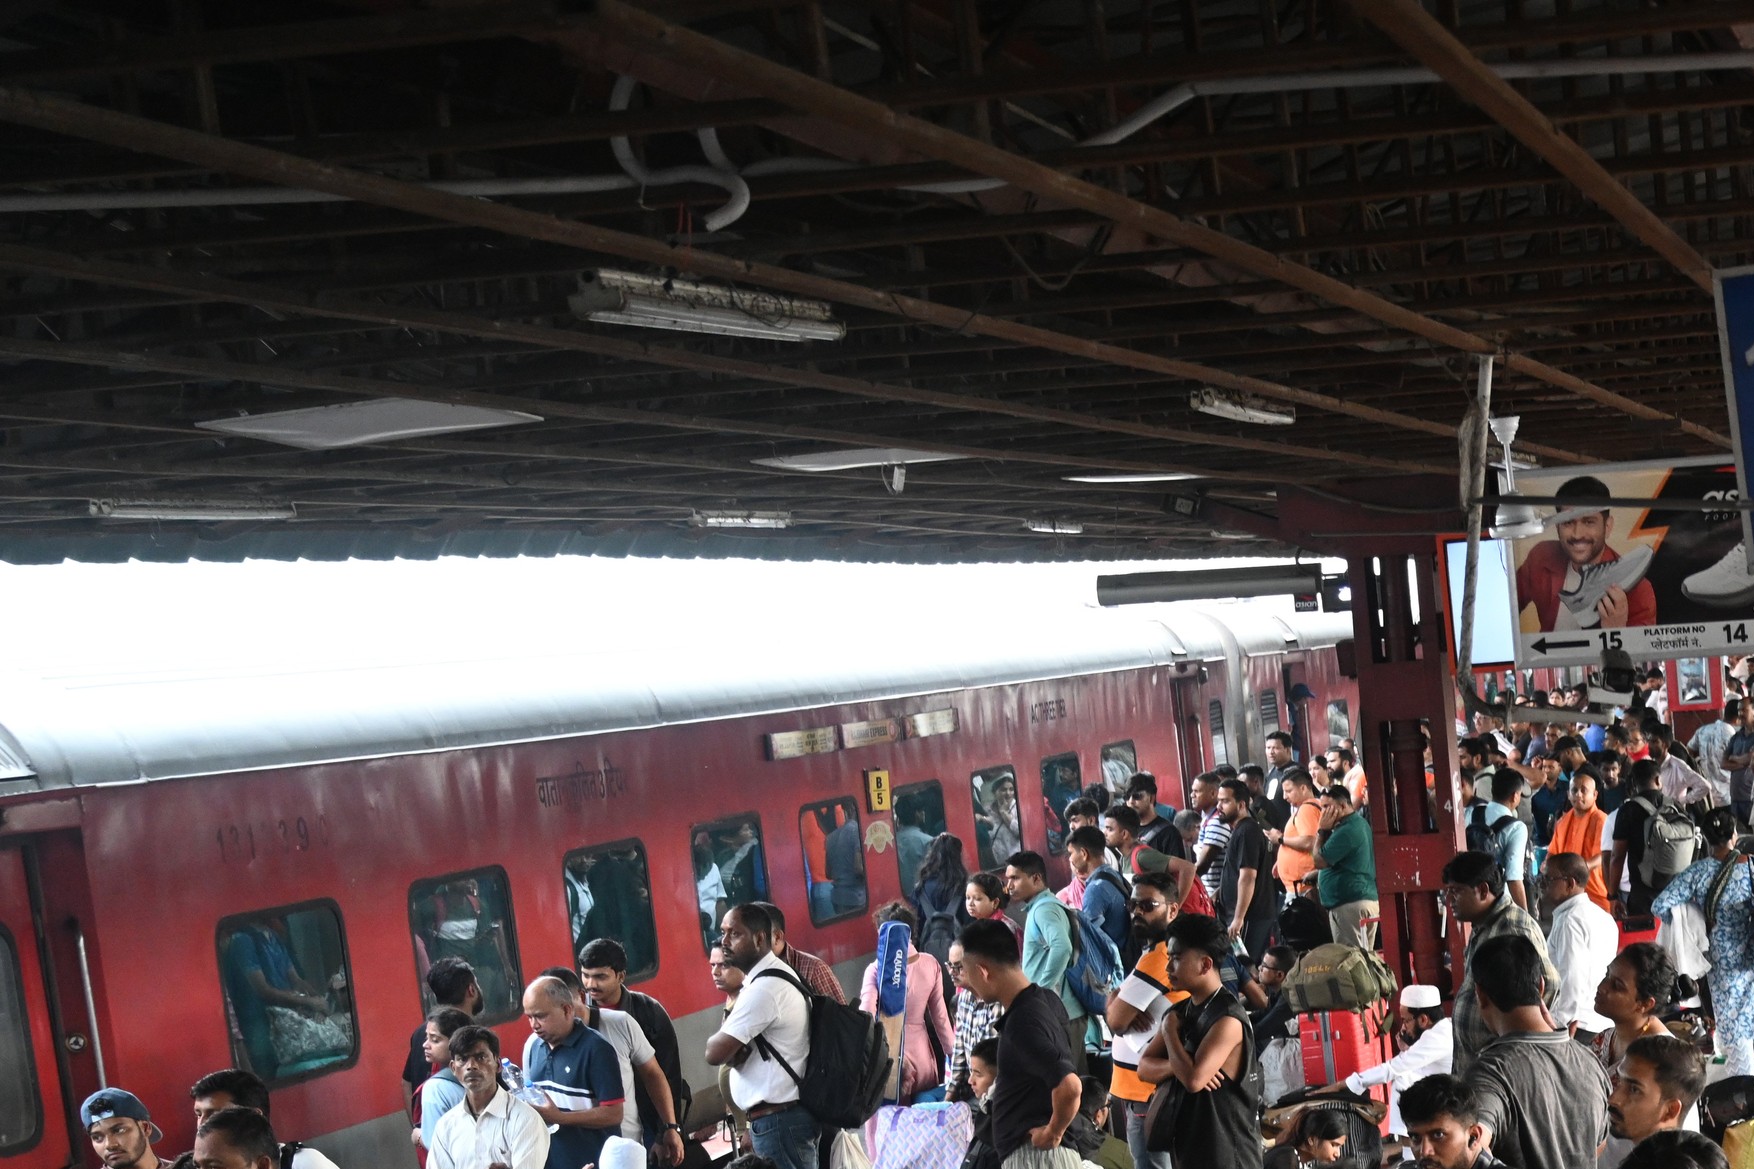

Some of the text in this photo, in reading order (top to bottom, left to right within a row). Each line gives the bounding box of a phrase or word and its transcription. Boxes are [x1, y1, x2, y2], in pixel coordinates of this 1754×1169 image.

[1644, 625, 1706, 636] PLATFORM NO
[1722, 623, 1749, 644] 14
[1599, 631, 1623, 651] 15
[875, 776, 883, 789] B
[876, 793, 883, 806] 5
[1444, 799, 1453, 813] 4
